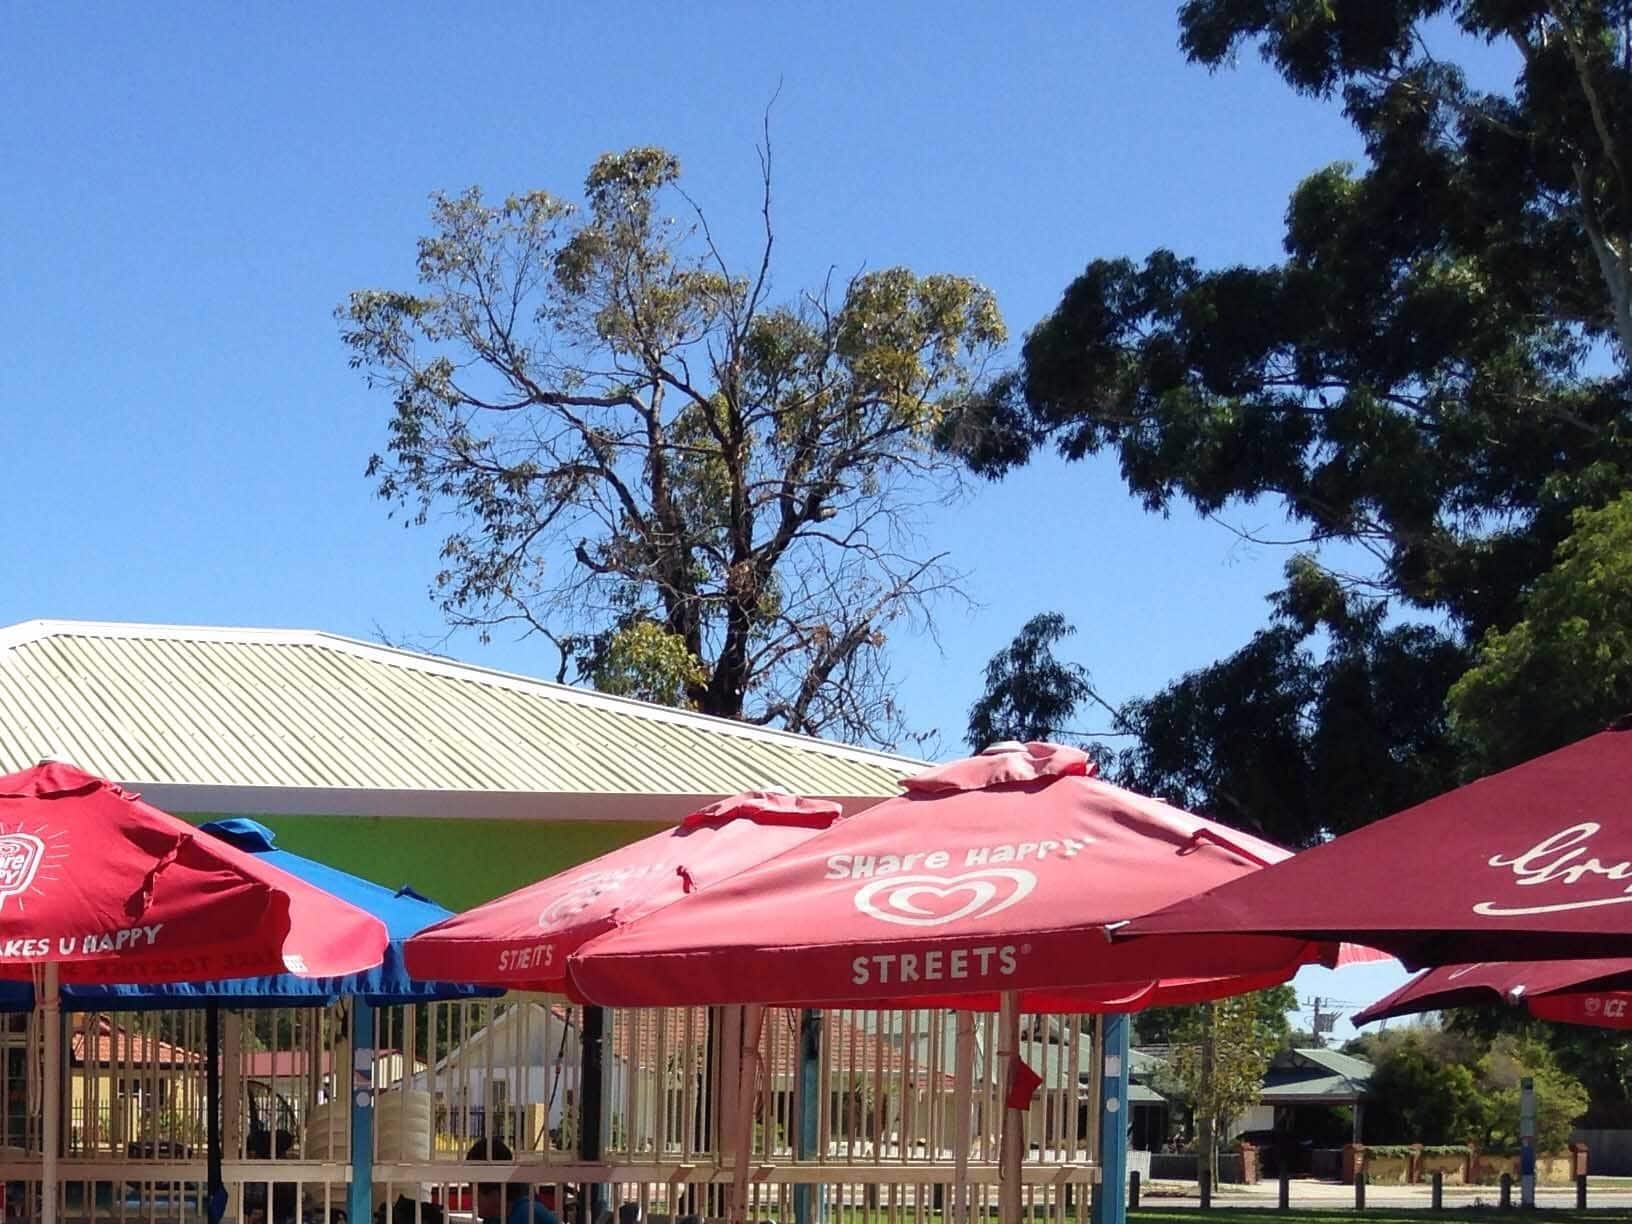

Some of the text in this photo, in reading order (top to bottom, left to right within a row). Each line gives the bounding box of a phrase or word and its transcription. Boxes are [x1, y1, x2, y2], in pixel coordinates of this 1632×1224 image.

[58, 936, 76, 955] U
[82, 923, 163, 954] HAPPY
[852, 945, 1017, 985] STREETS
[1603, 1000, 1628, 1017] ICE
